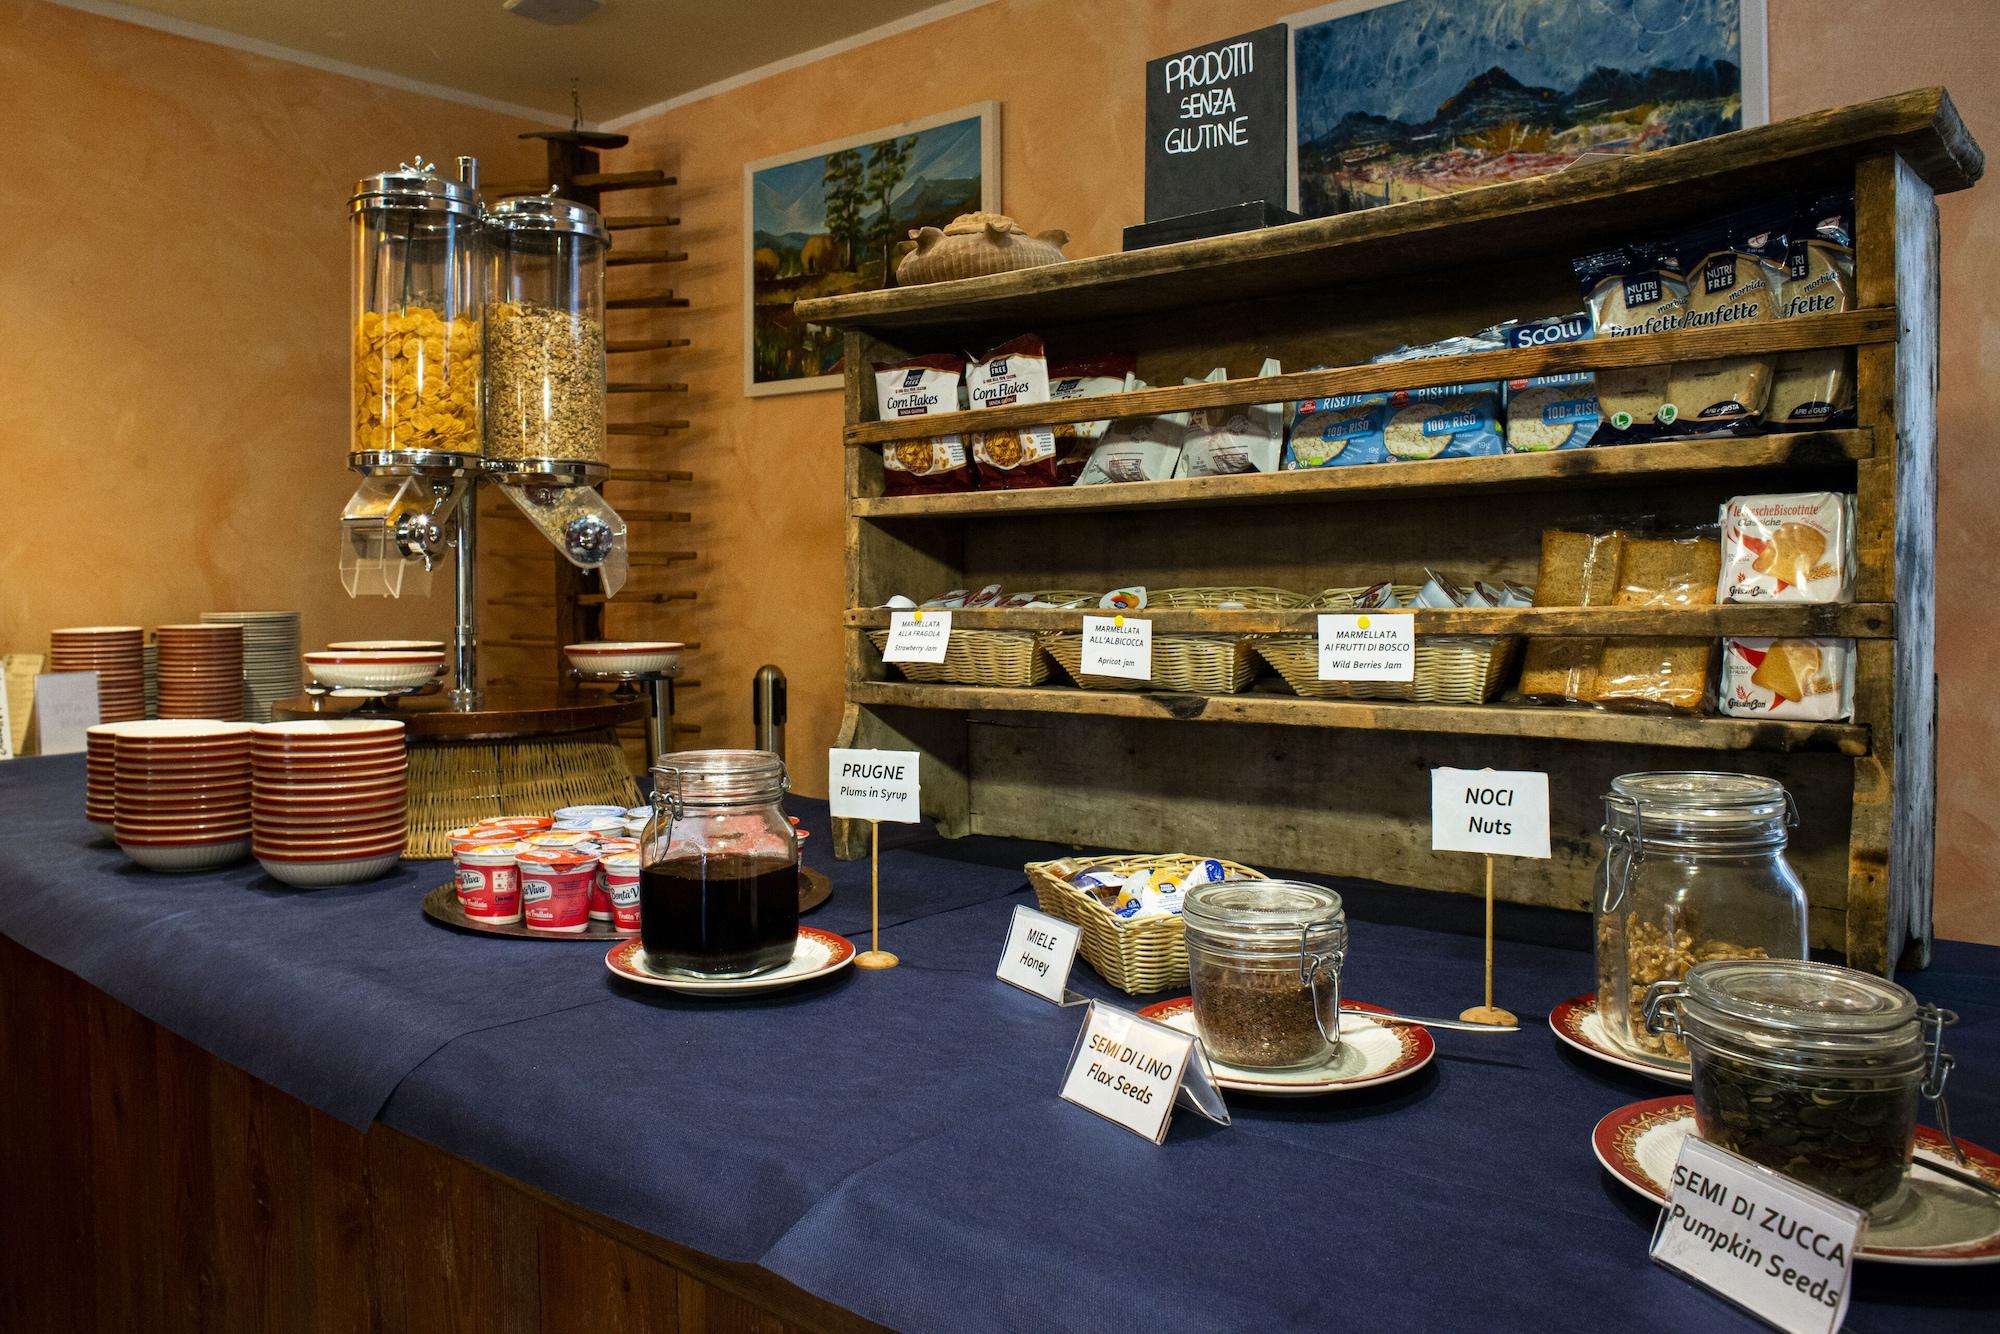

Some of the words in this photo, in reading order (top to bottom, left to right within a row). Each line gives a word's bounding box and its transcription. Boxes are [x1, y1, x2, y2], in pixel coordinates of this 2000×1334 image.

[1165, 41, 1253, 94] PRODOTTI
[1180, 87, 1236, 118] SENZA
[1164, 116, 1249, 154] GLUTINE
[1707, 265, 1733, 280] NUTRI
[1627, 281, 1658, 296] NUTRI
[1708, 275, 1733, 290] FREE
[1629, 290, 1659, 305] FREE
[1683, 302, 1758, 329] Panfette
[991, 366, 1007, 375] FREE
[973, 387, 997, 401] Corn
[998, 382, 1029, 397] Flakes
[887, 397, 908, 410] Corn
[909, 394, 939, 408] Flakes
[1348, 421, 1369, 433] RISO
[1427, 419, 1450, 432] 100%
[1453, 415, 1476, 429] RISO
[1095, 625, 1140, 634] MARMELLATA
[1336, 631, 1397, 639] MARMELLATA
[895, 645, 924, 653] Strawberry
[1090, 636, 1144, 647] ALL'ALBICOCCA
[1378, 644, 1410, 652] BOSCO
[1098, 657, 1121, 666] Apricot
[1122, 658, 1135, 668] jam
[1332, 660, 1351, 669] Wild
[1353, 660, 1382, 669] Berries
[1384, 661, 1402, 669] Jam
[842, 763, 905, 780] PRUGNE
[840, 786, 867, 798] Plums
[869, 786, 878, 798] in
[881, 788, 908, 802] Syrup
[1465, 788, 1513, 806] NOCI
[1469, 816, 1512, 835] Nuts
[1027, 928, 1057, 951] MIELE
[1020, 951, 1050, 977] Honey
[1089, 1034, 1121, 1059] SEMI
[1120, 1048, 1138, 1066] DI
[1136, 1054, 1172, 1081] LINO
[1087, 1062, 1115, 1086] Flax
[1113, 1074, 1153, 1105] Seeds
[1672, 1164, 1728, 1207] SEMI
[1731, 1195, 1756, 1221] DI
[1760, 1207, 1846, 1268] ZUCCA
[1668, 1204, 1763, 1268] Pumpkin
[1765, 1254, 1840, 1308] Seeds
